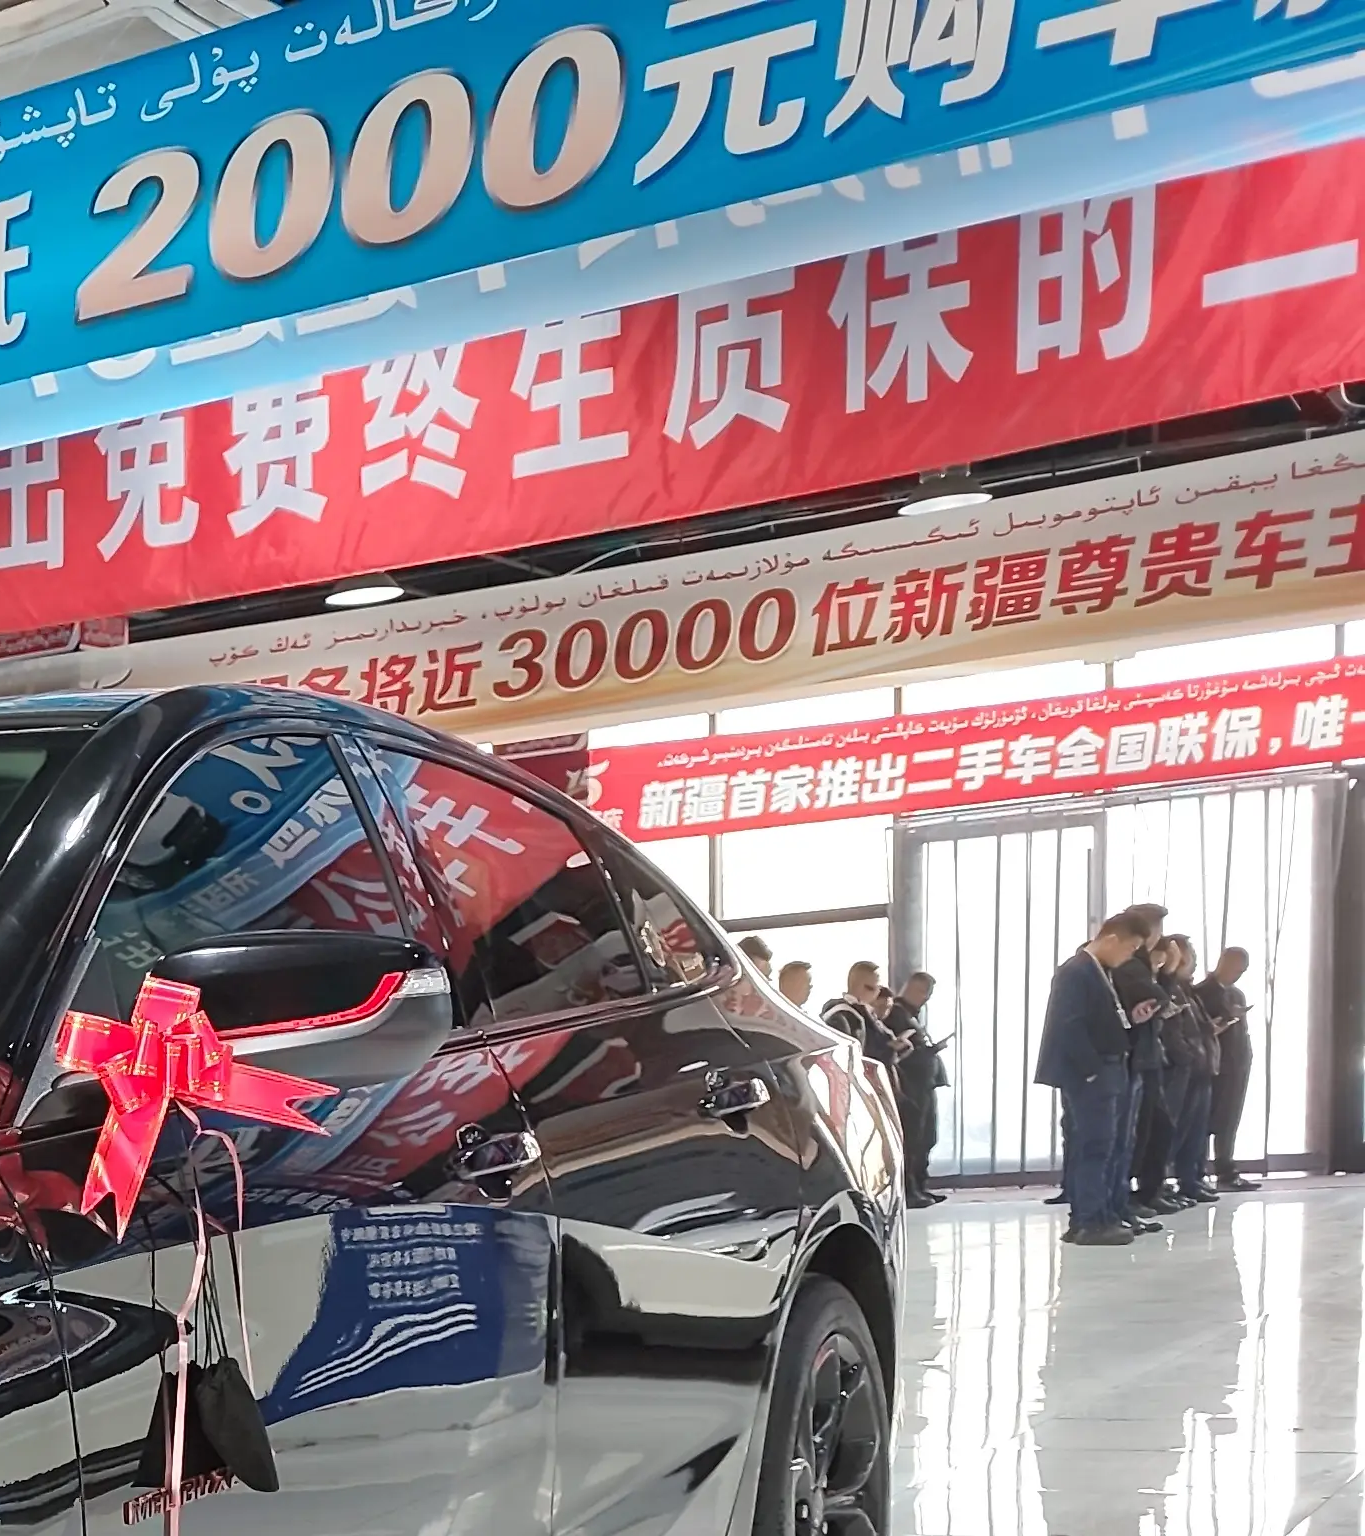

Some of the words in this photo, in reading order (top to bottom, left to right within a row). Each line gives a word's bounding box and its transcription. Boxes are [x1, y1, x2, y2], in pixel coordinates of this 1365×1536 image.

[636, 694, 1365, 831] 新疆首家推出二手车全国联保，唯
